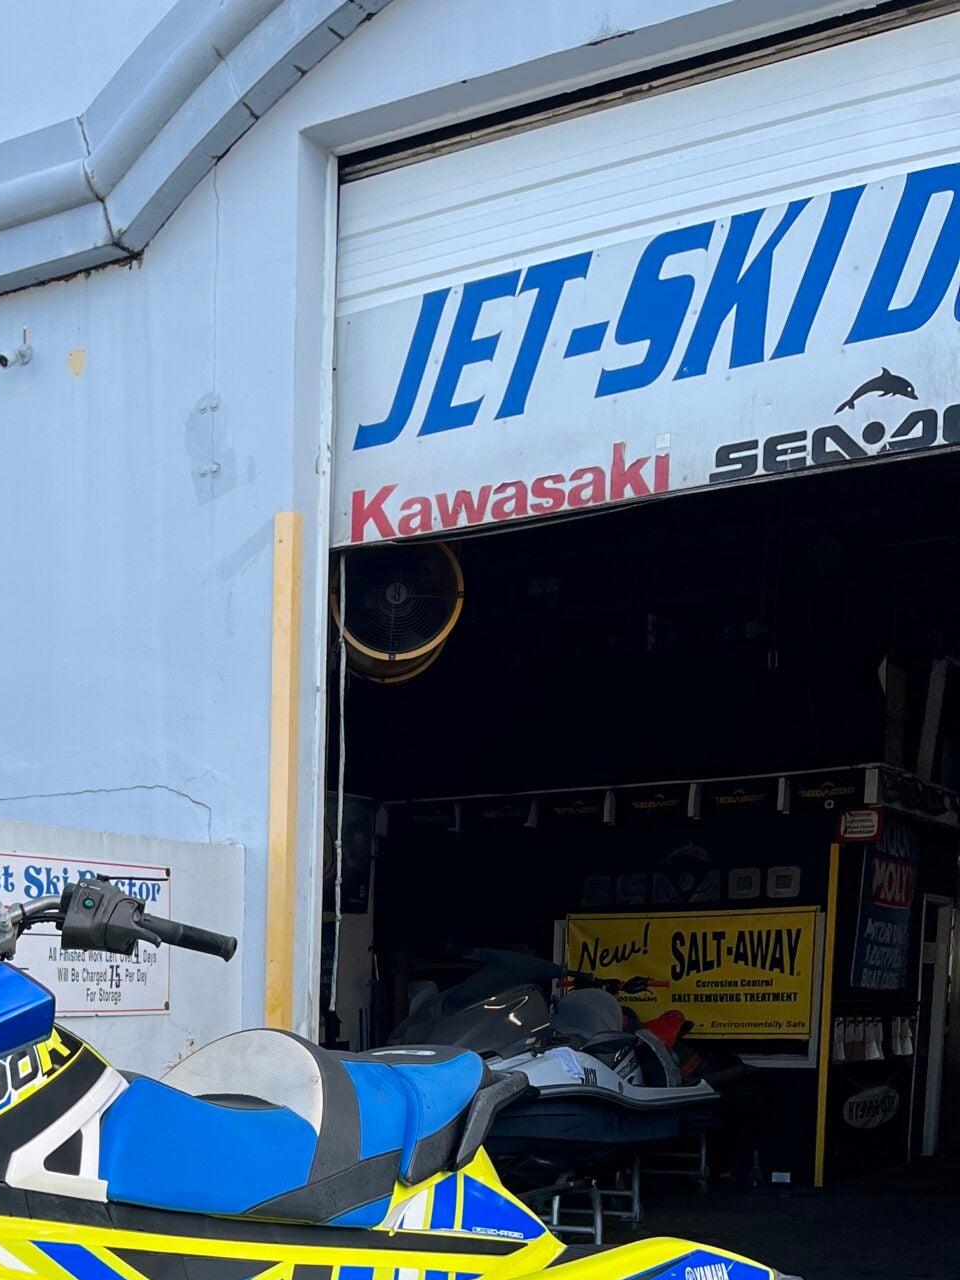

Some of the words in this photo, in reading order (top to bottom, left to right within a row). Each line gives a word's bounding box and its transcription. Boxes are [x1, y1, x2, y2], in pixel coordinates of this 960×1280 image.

[353, 184, 867, 451] JET-SKI
[843, 163, 960, 346] D
[350, 442, 671, 543] Kawasaki
[23, 864, 71, 899] Ski
[48, 946, 57, 962] All
[143, 949, 157, 966] Days
[577, 922, 650, 972] New!
[671, 928, 802, 981] SALT-AWAY
[57, 967, 69, 982] Will
[71, 968, 80, 982] Be
[82, 967, 107, 985] Charged
[125, 968, 135, 982] Per
[136, 968, 147, 985] Day
[695, 979, 739, 989] Corrosion
[740, 978, 774, 988] Control
[86, 988, 96, 1002] For
[98, 988, 122, 1005] Storage
[671, 992, 692, 1003] SALT
[693, 992, 741, 1003] REMOVING
[743, 991, 799, 1003] TREATMENT
[710, 1019, 783, 1030] Environmentally
[785, 1019, 806, 1029] Safe
